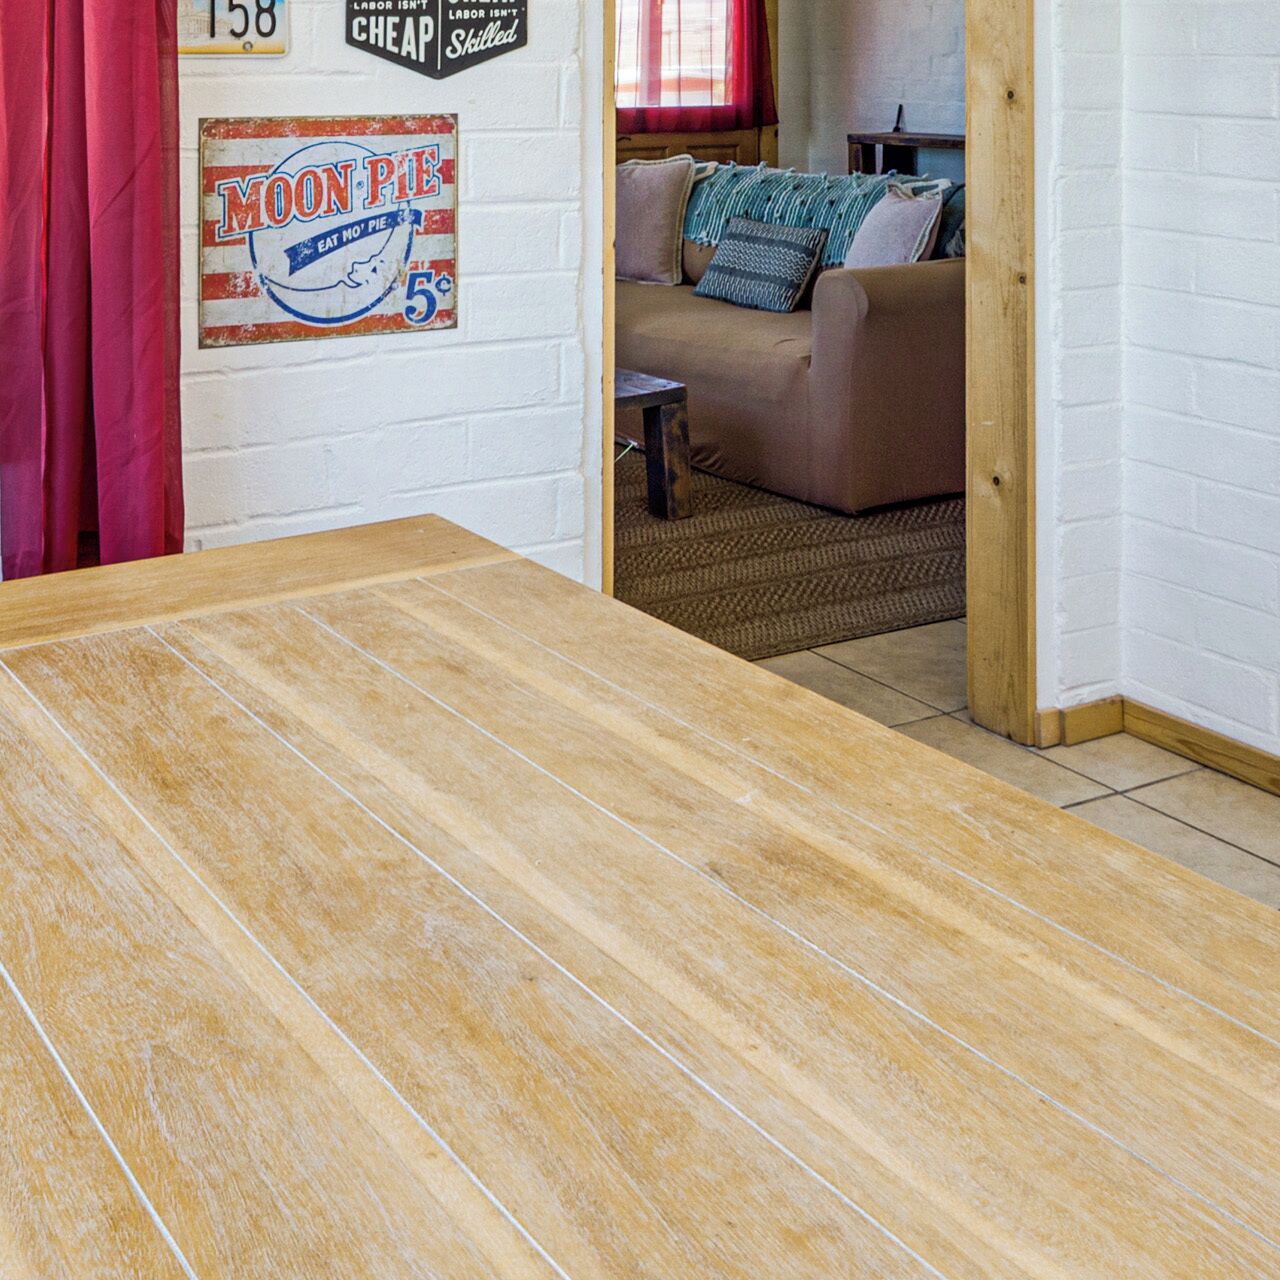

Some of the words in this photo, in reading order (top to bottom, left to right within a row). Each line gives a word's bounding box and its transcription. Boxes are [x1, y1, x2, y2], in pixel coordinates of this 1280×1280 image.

[353, 0, 393, 10] LABOR
[398, 0, 428, 10] ISN'T
[449, 9, 485, 20] LABOR
[490, 8, 518, 17] ISN'T
[352, 16, 434, 63] CHEAP
[445, 19, 519, 59] Skilled
[222, 163, 356, 235] MOON
[367, 147, 438, 207] PIE
[317, 233, 339, 253] EAT
[343, 224, 366, 241] MO'
[368, 216, 387, 233] PIE
